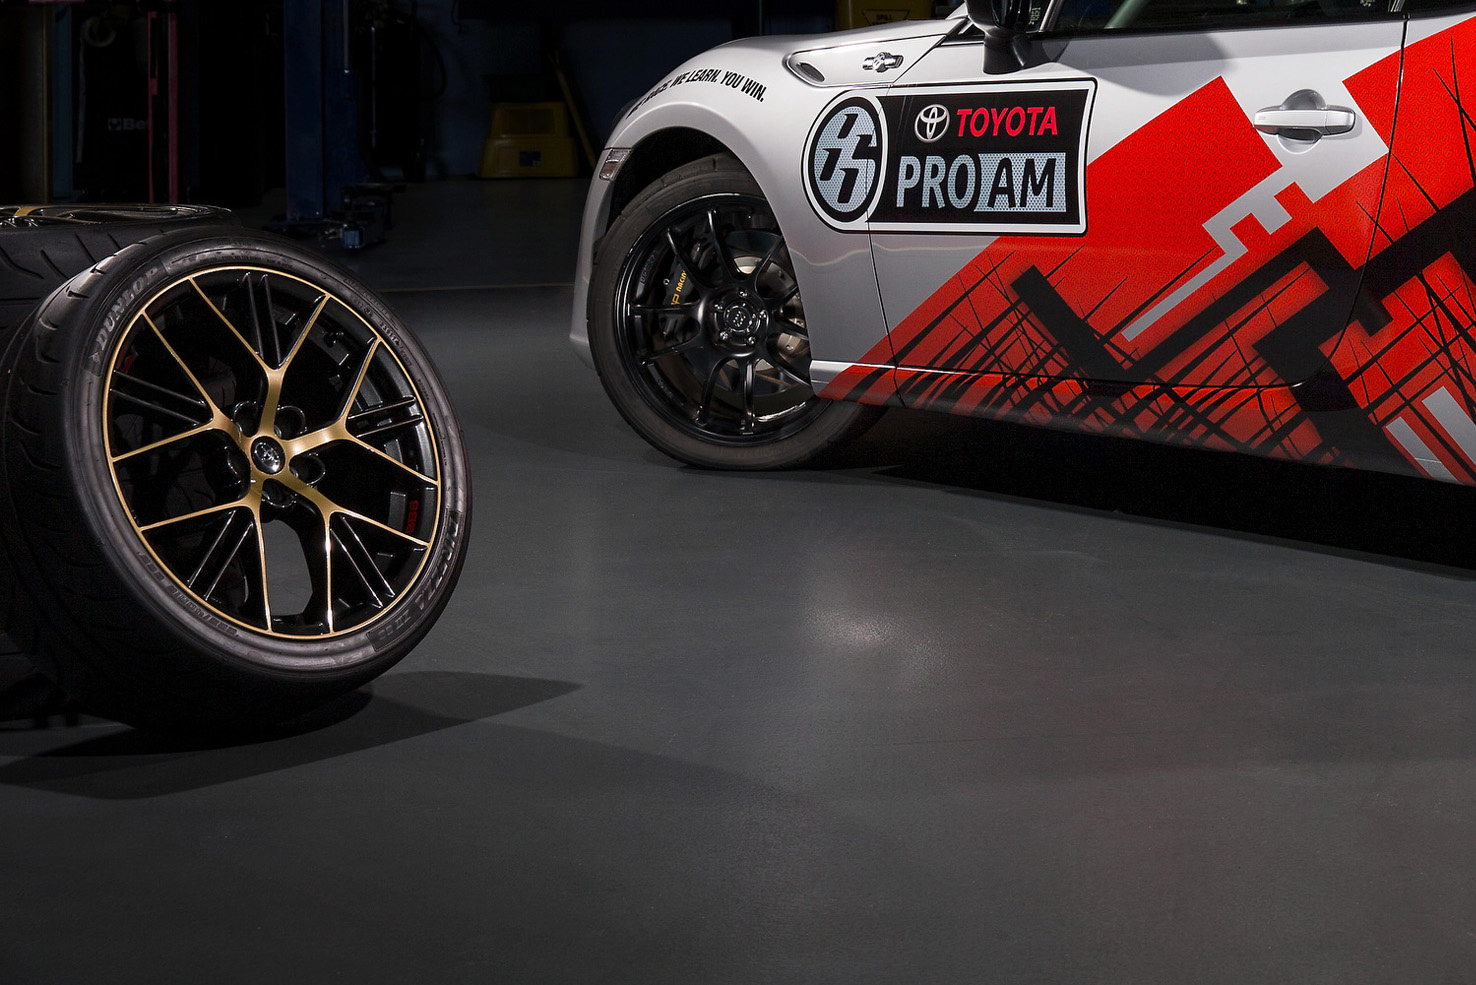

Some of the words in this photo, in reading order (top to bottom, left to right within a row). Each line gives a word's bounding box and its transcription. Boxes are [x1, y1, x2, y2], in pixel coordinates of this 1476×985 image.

[685, 69, 721, 83] LEARN.
[720, 70, 746, 89] YOU
[741, 78, 768, 103] WIN.
[957, 106, 1058, 137] TOYOTA
[676, 269, 688, 293] RACIN
[95, 266, 159, 351] DUNLOP
